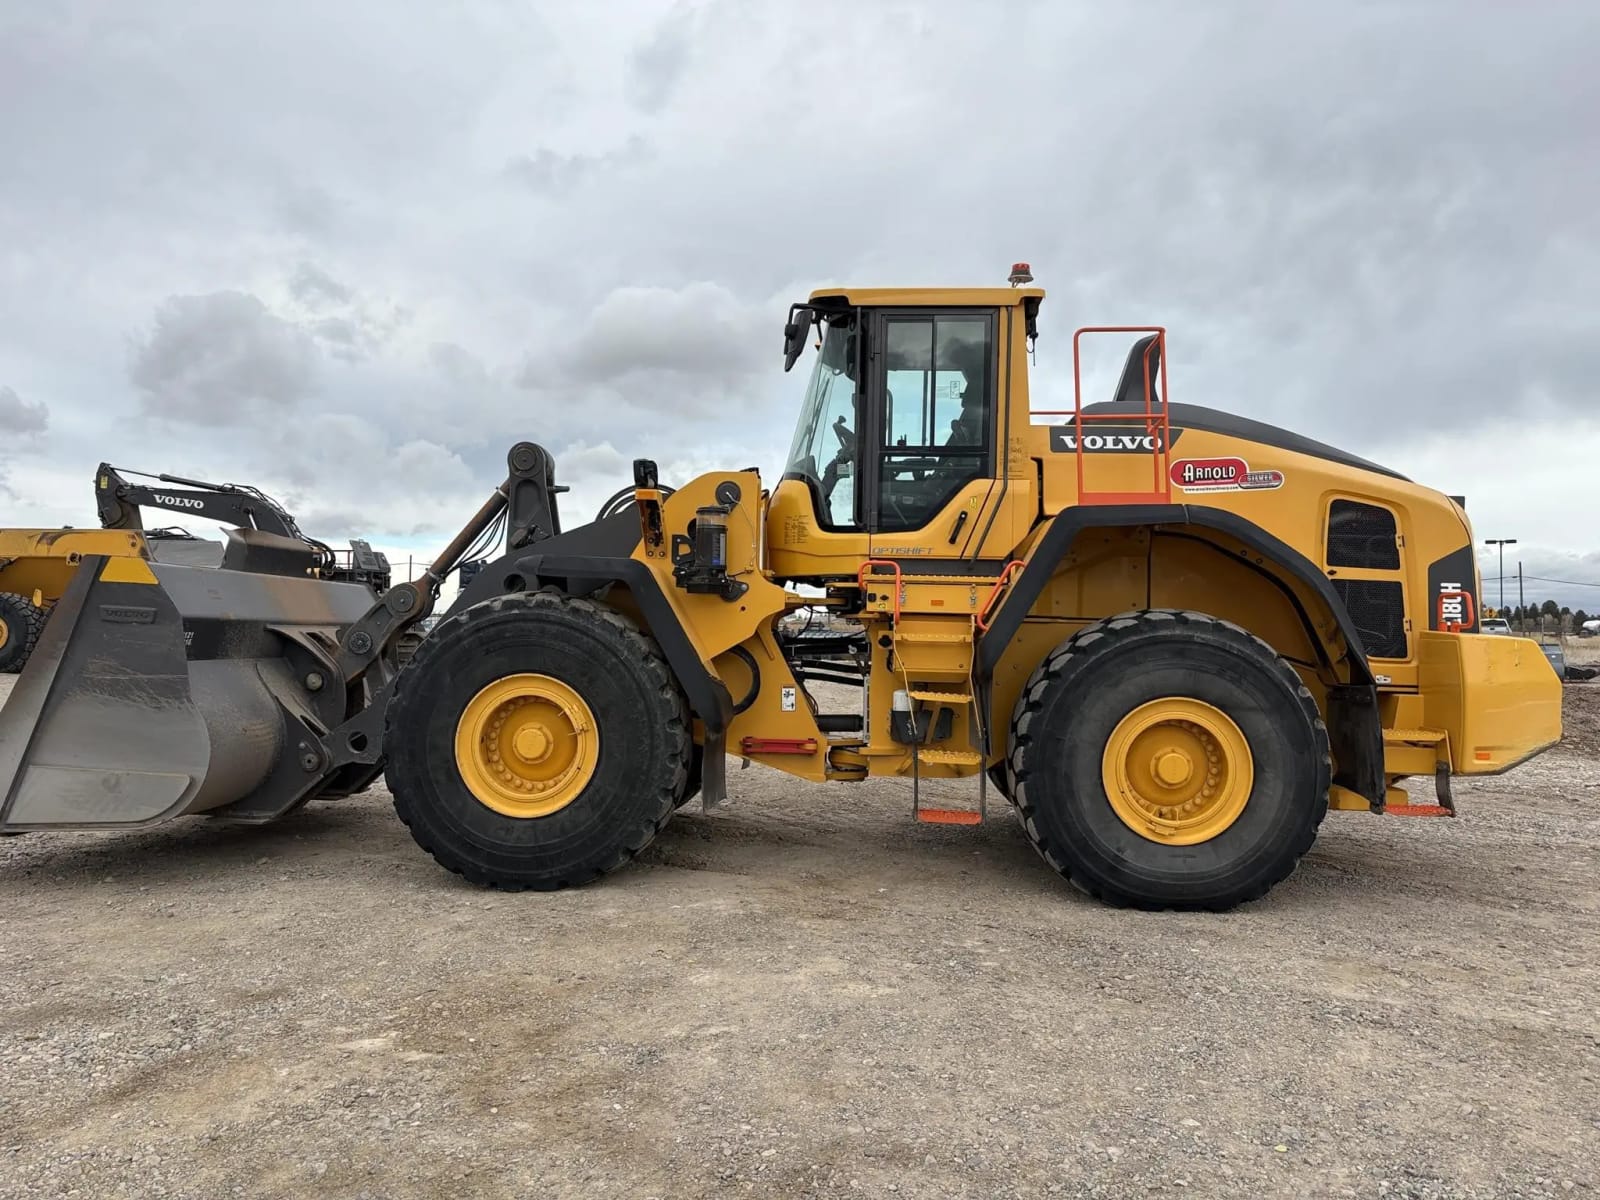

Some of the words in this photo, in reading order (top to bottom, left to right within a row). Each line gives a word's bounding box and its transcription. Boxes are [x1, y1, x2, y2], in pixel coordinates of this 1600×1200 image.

[1059, 435, 1162, 450] VOLVO
[1183, 463, 1236, 482] ARNOLD
[153, 494, 204, 509] VOLVO
[872, 547, 934, 555] OPTISHIFT
[104, 609, 149, 619] VOLVO
